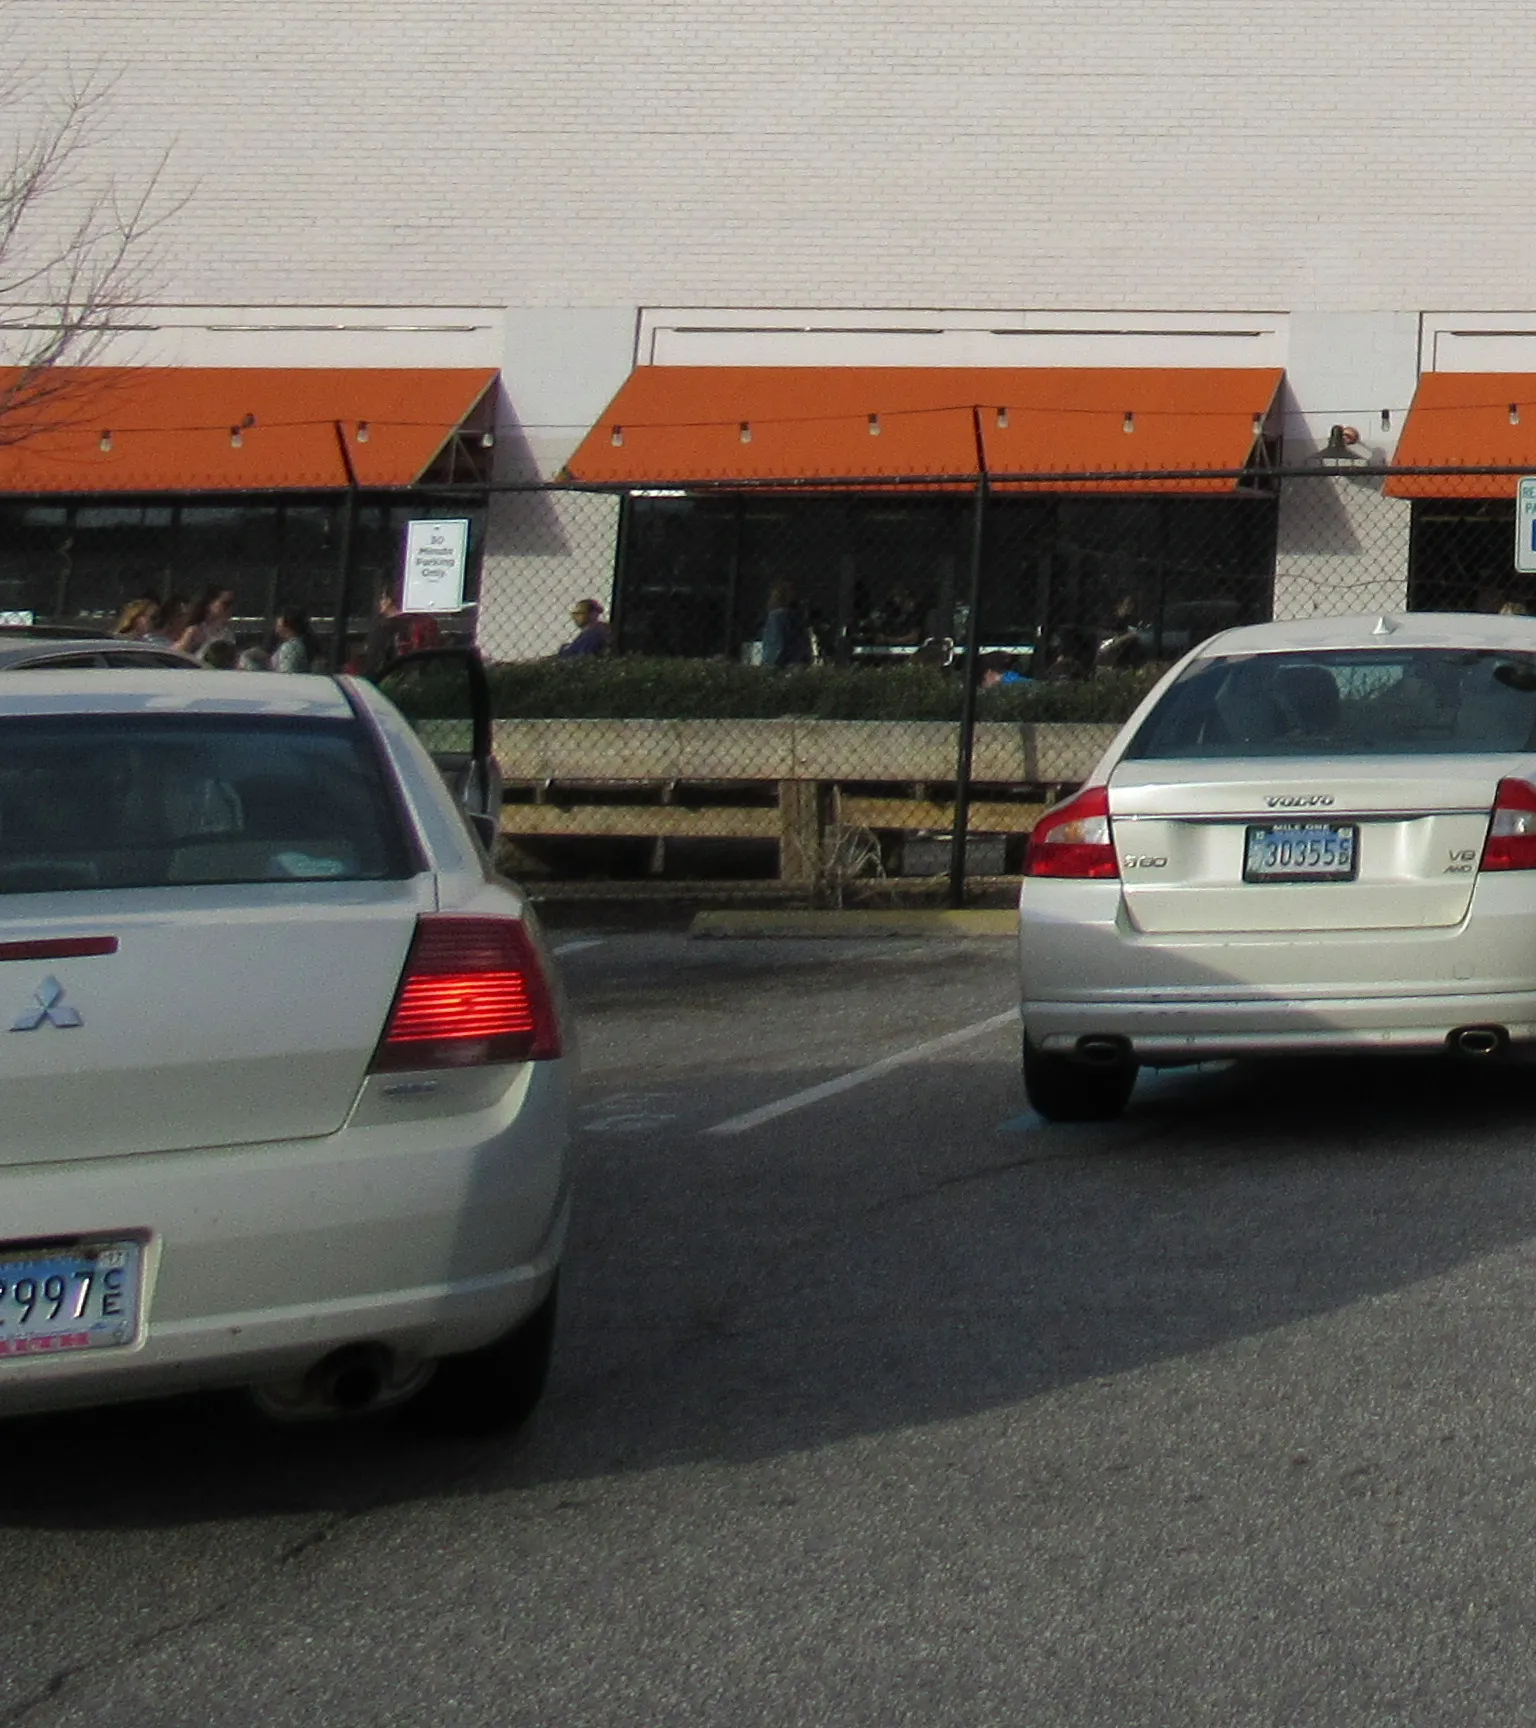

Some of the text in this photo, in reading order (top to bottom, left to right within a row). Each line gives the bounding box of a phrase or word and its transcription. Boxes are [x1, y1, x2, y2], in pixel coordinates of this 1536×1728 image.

[416, 558, 455, 568] Parking
[1263, 795, 1334, 807] VOLVO
[1264, 839, 1336, 867] 30355
